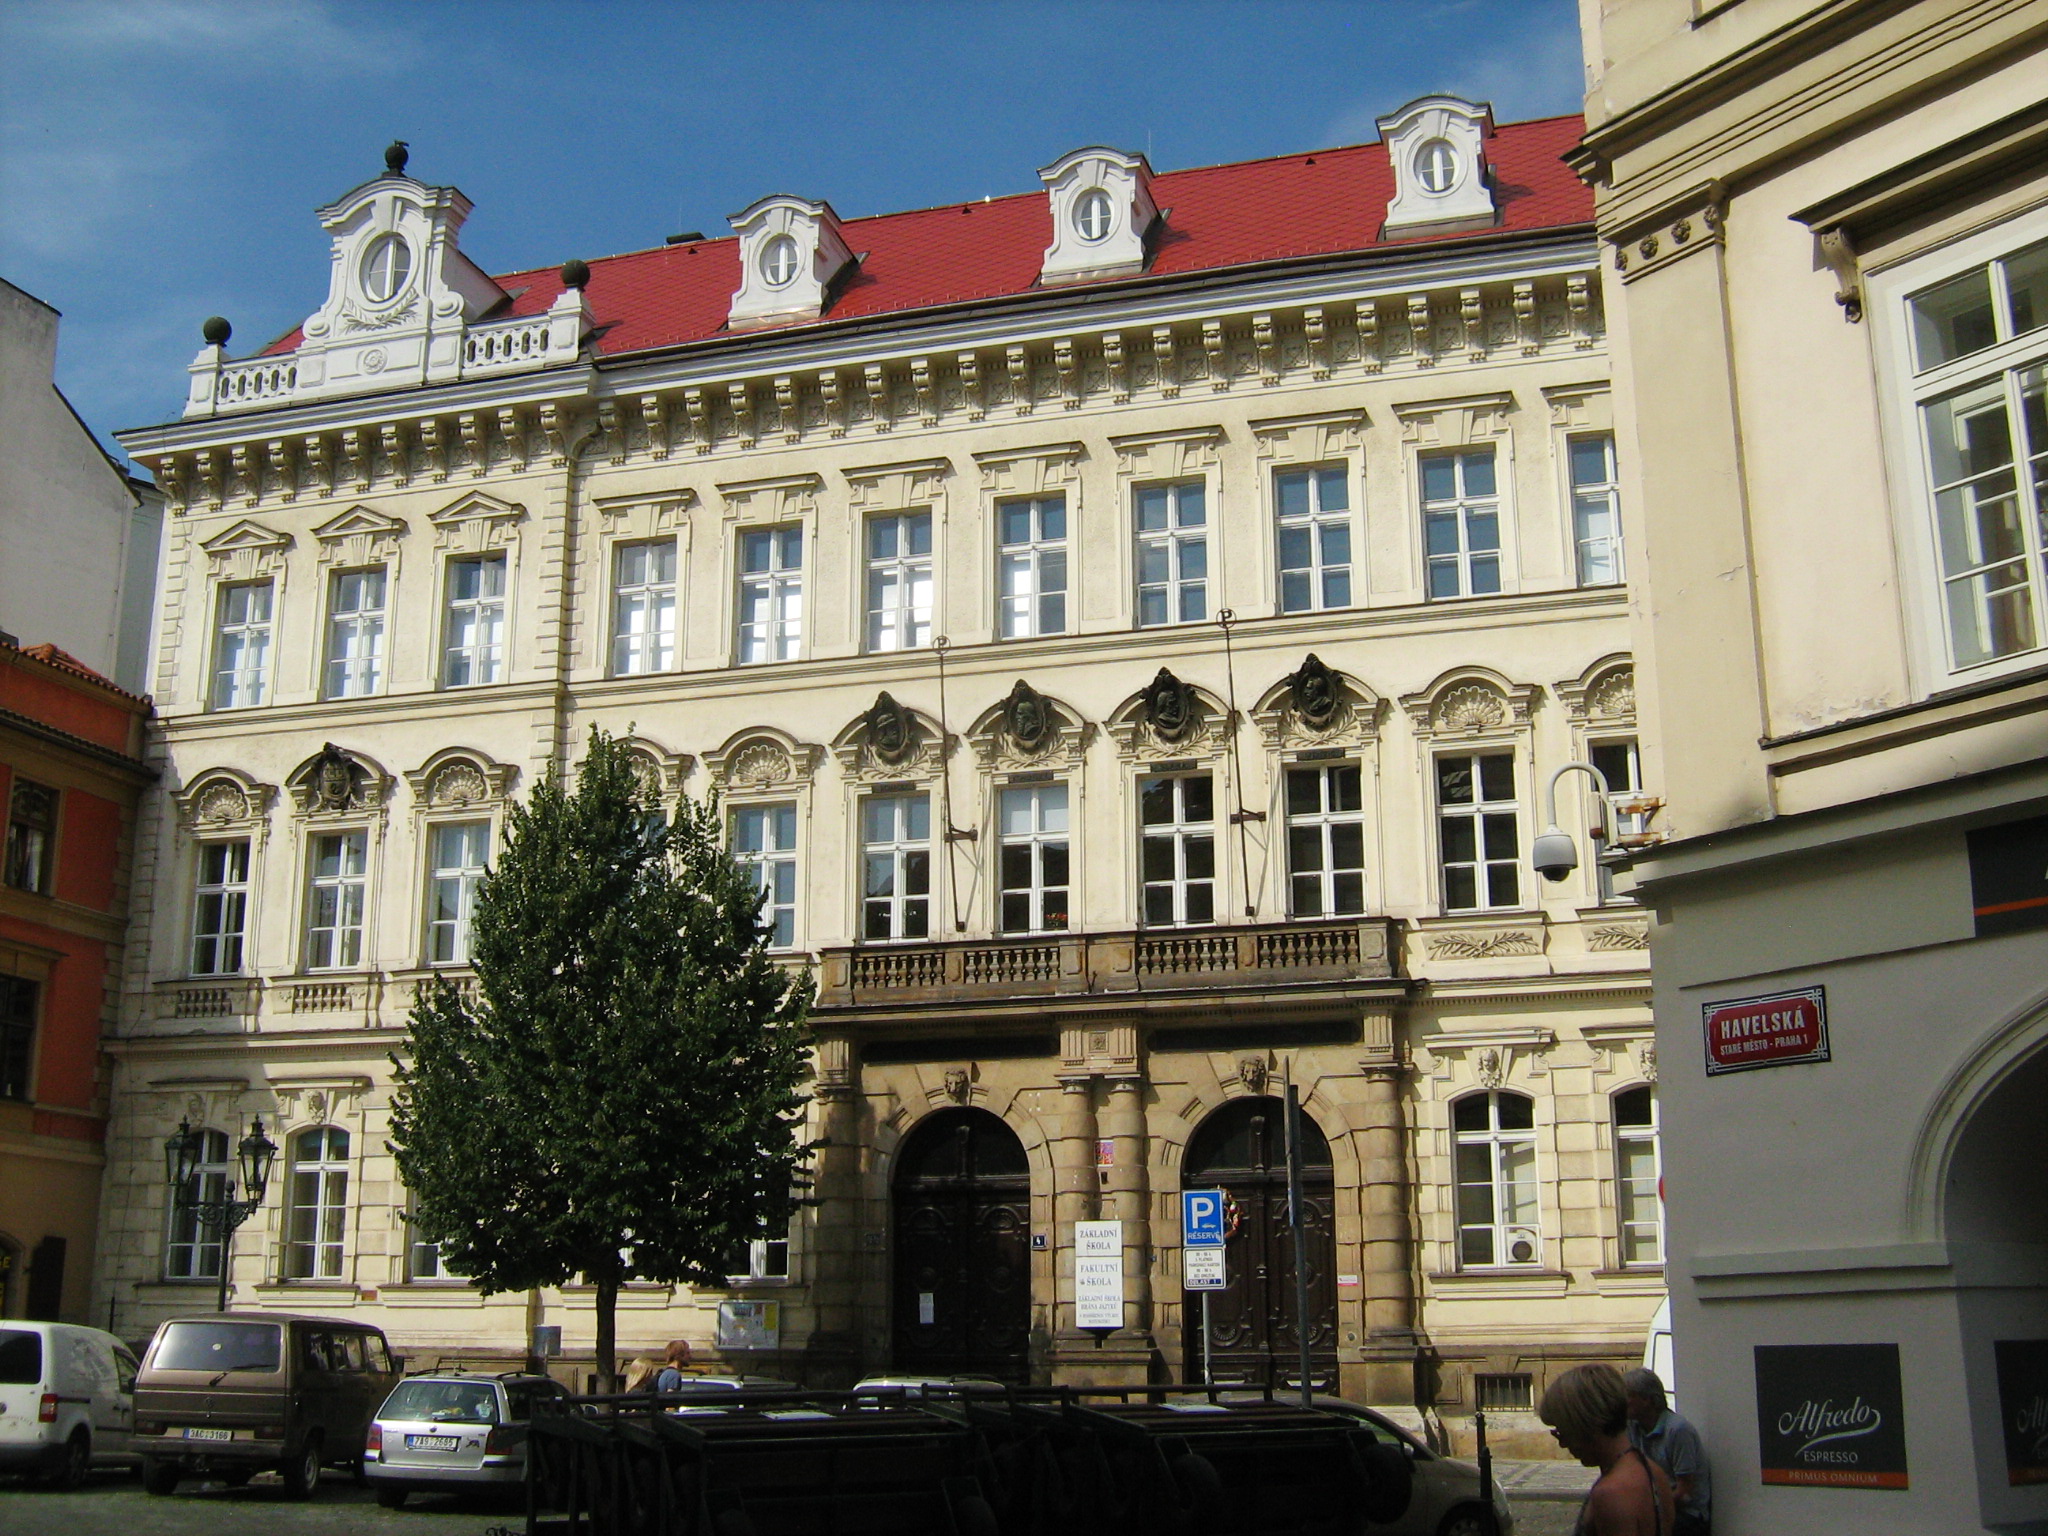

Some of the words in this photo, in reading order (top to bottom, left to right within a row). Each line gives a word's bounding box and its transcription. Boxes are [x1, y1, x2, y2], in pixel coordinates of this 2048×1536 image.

[1720, 1005, 1805, 1040] HAVELSKÁ
[1720, 1040, 1742, 1056] STARÉ
[1775, 1035, 1802, 1048] PRAHA
[1804, 1034, 1808, 1044] 1
[1191, 1197, 1214, 1229] P
[1080, 1229, 1117, 1238] ZÁKLADNÍ
[1086, 1240, 1111, 1250] ŠKOLA
[1080, 1262, 1118, 1273] FAKULTNÍ
[1086, 1276, 1112, 1286] ŠKOLA
[1778, 1396, 1879, 1440] Alfredo
[1803, 1451, 1858, 1463] ESPRESSO
[1788, 1470, 1827, 1482] PRIMUS
[1829, 1471, 1877, 1484] OMNIUM
